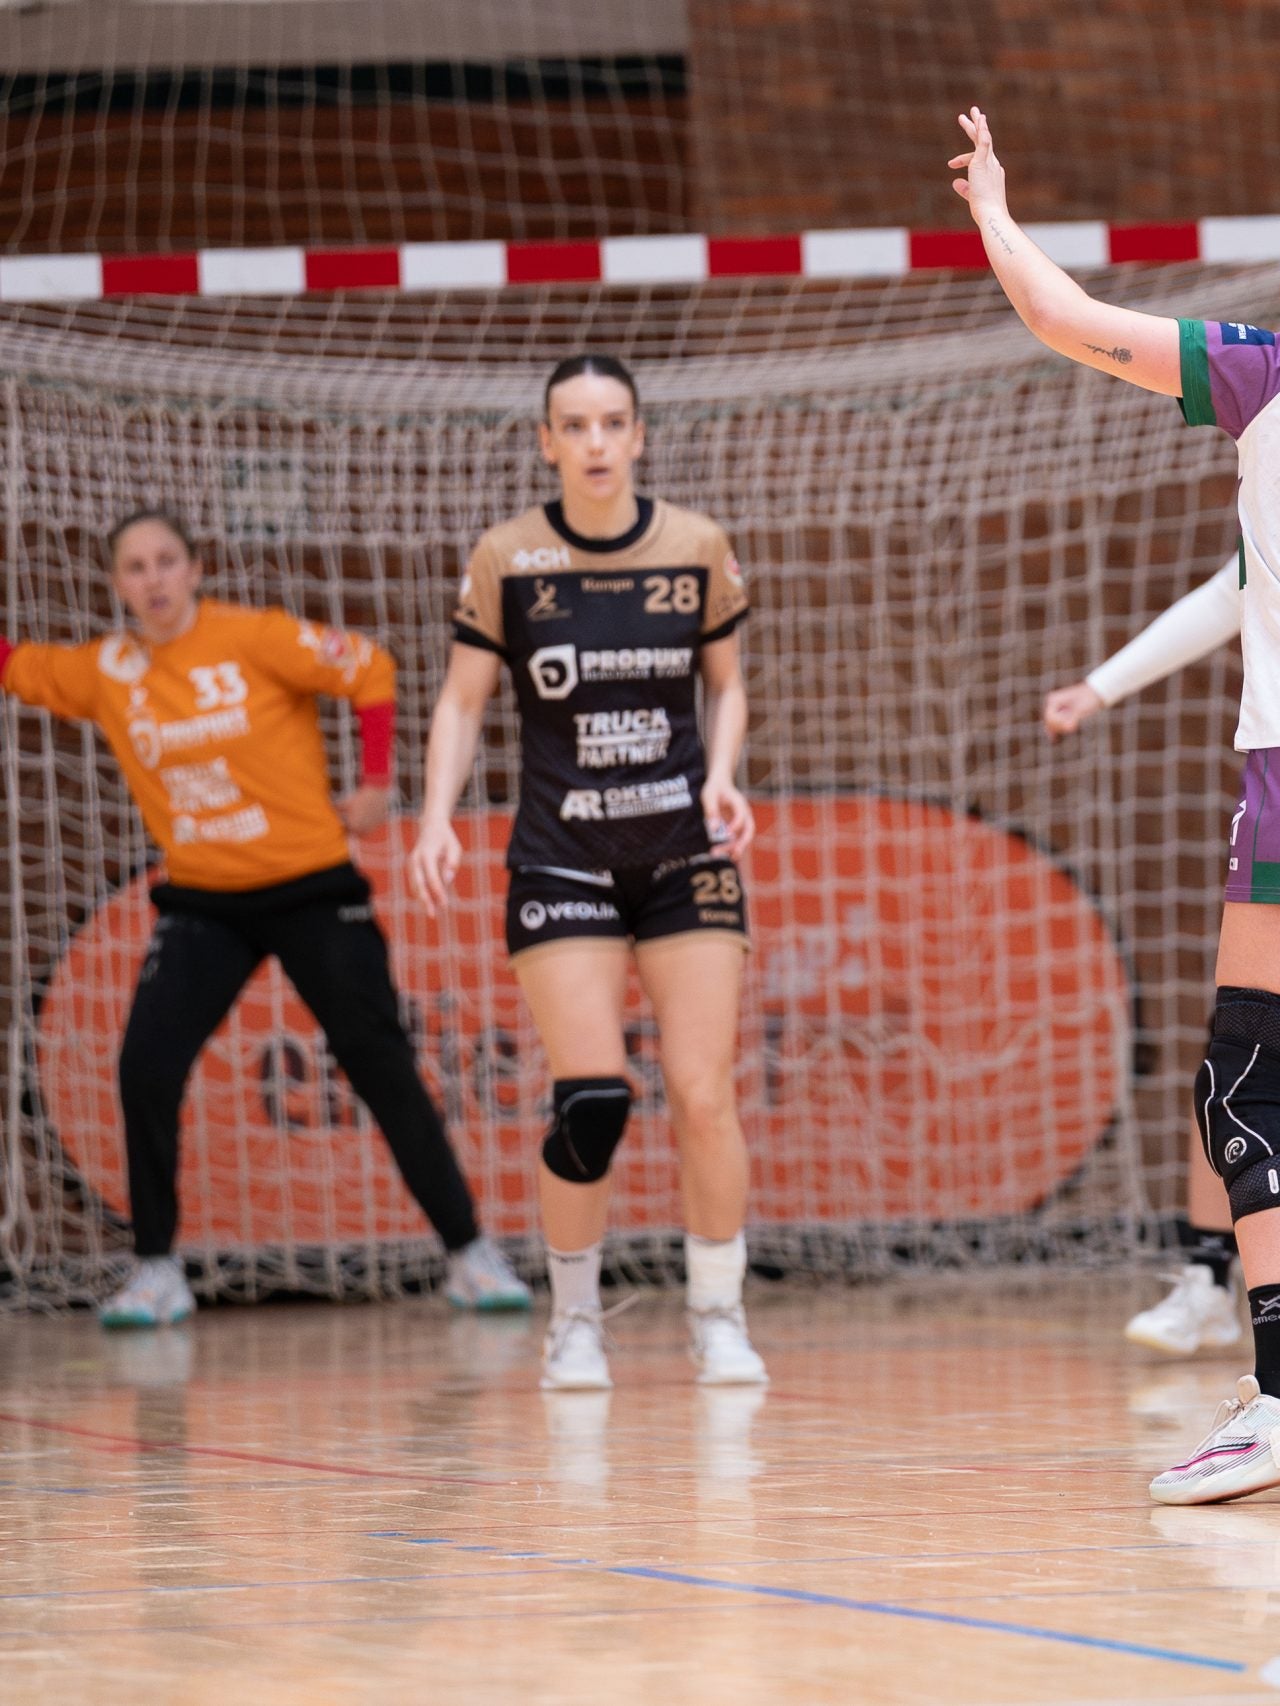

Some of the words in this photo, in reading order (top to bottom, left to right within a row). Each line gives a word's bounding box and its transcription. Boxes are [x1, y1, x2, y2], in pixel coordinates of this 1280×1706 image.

[642, 574, 701, 615] 28
[690, 867, 742, 906] 28
[546, 900, 621, 922] VEOLIA
